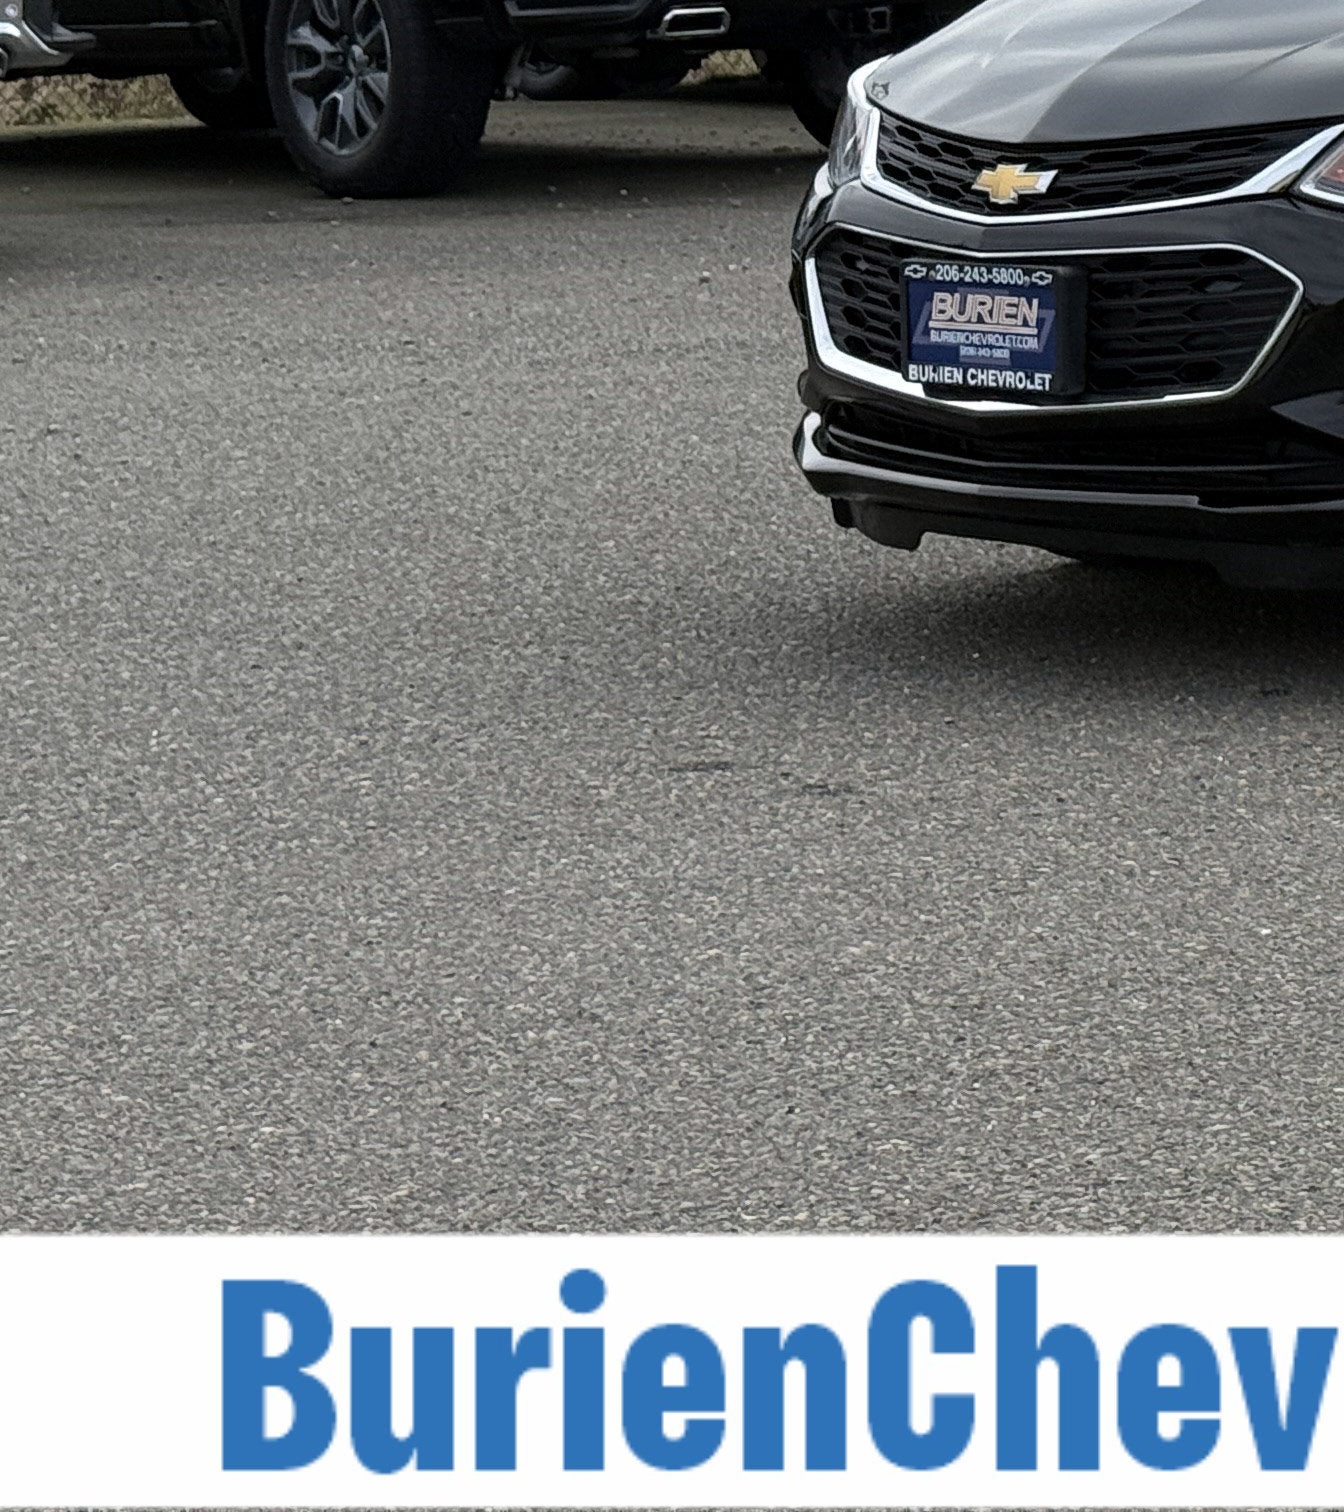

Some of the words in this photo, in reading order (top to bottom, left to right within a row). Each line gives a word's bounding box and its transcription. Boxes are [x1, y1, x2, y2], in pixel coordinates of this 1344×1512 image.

[934, 264, 1025, 285] 206-243-5800
[932, 292, 1038, 325] BURIEN
[909, 364, 963, 384] BURIEN
